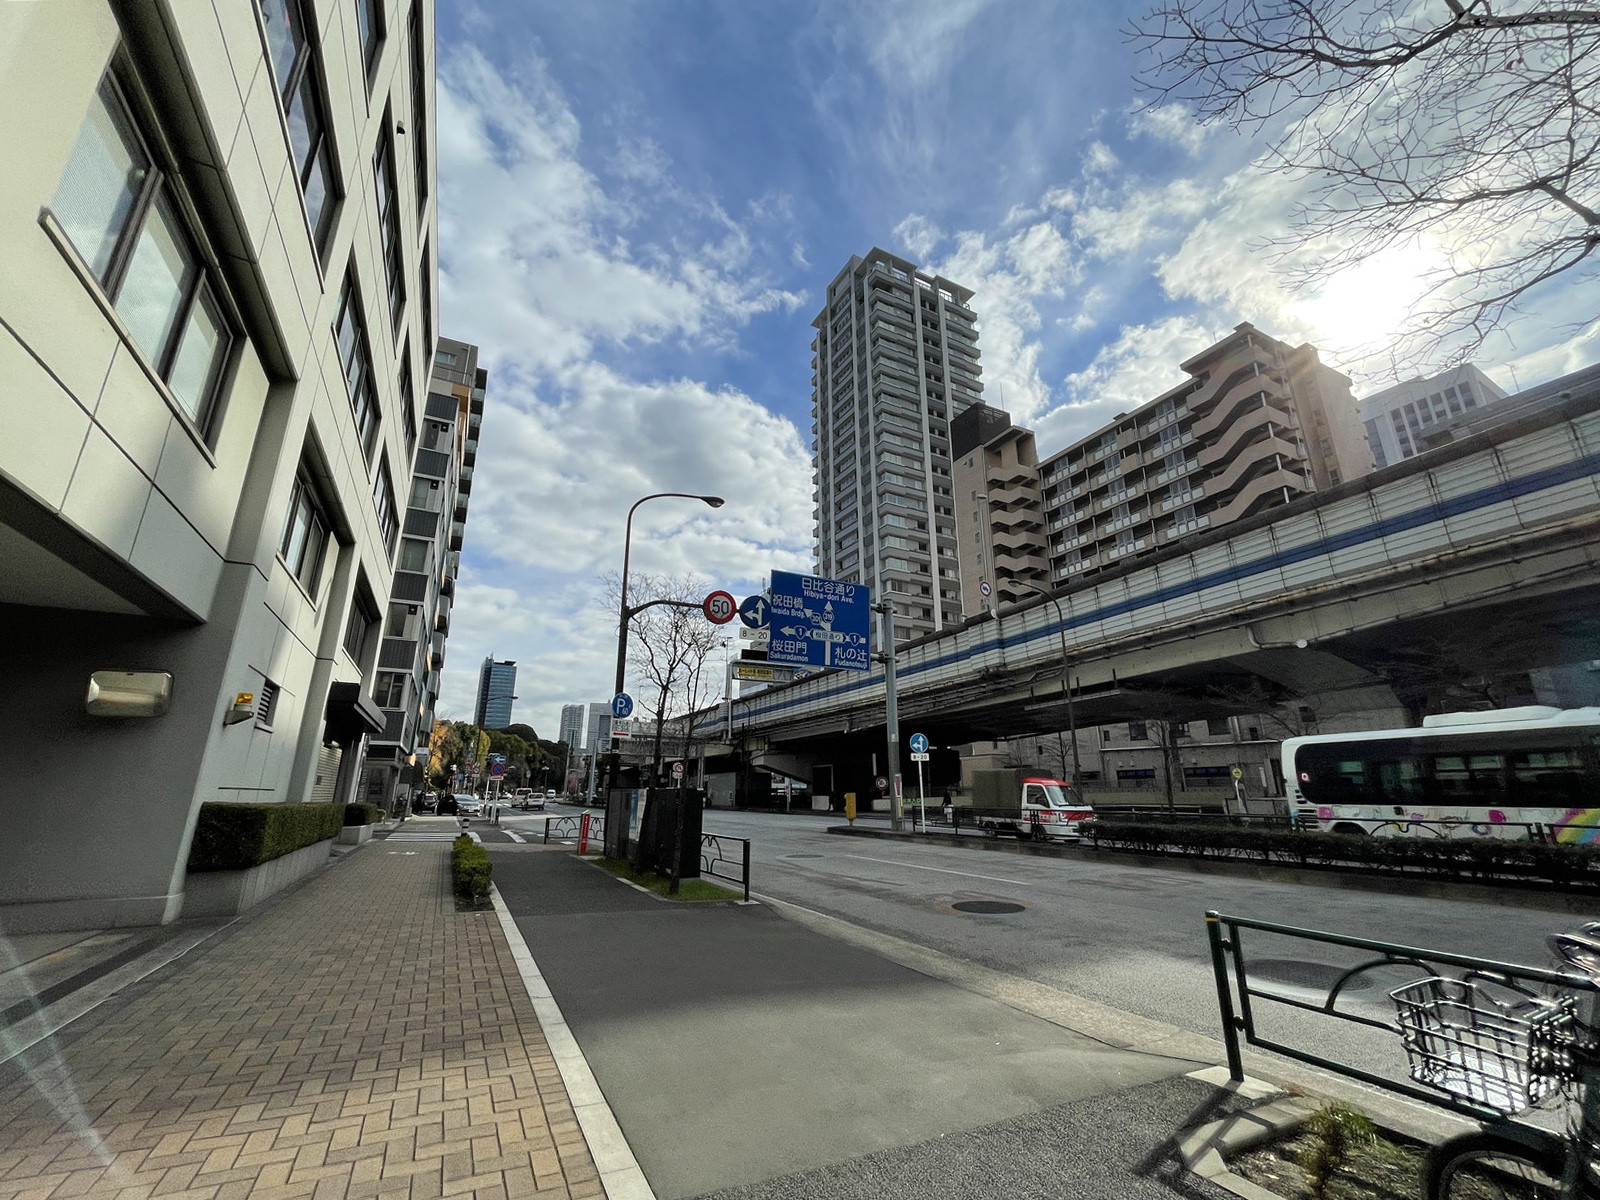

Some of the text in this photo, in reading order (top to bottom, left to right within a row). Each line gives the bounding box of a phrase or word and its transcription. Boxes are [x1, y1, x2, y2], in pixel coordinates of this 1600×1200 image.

[802, 577, 855, 597] 日比谷通り
[773, 594, 803, 610] 祝田橋
[804, 590, 854, 604] Hibiya-dori Ave.
[712, 600, 729, 615] 50
[799, 628, 802, 636] 1
[772, 639, 807, 654] 桜田門
[835, 646, 867, 662] 札の辻
[770, 652, 808, 662] Sakuradamon
[616, 698, 626, 714] P
